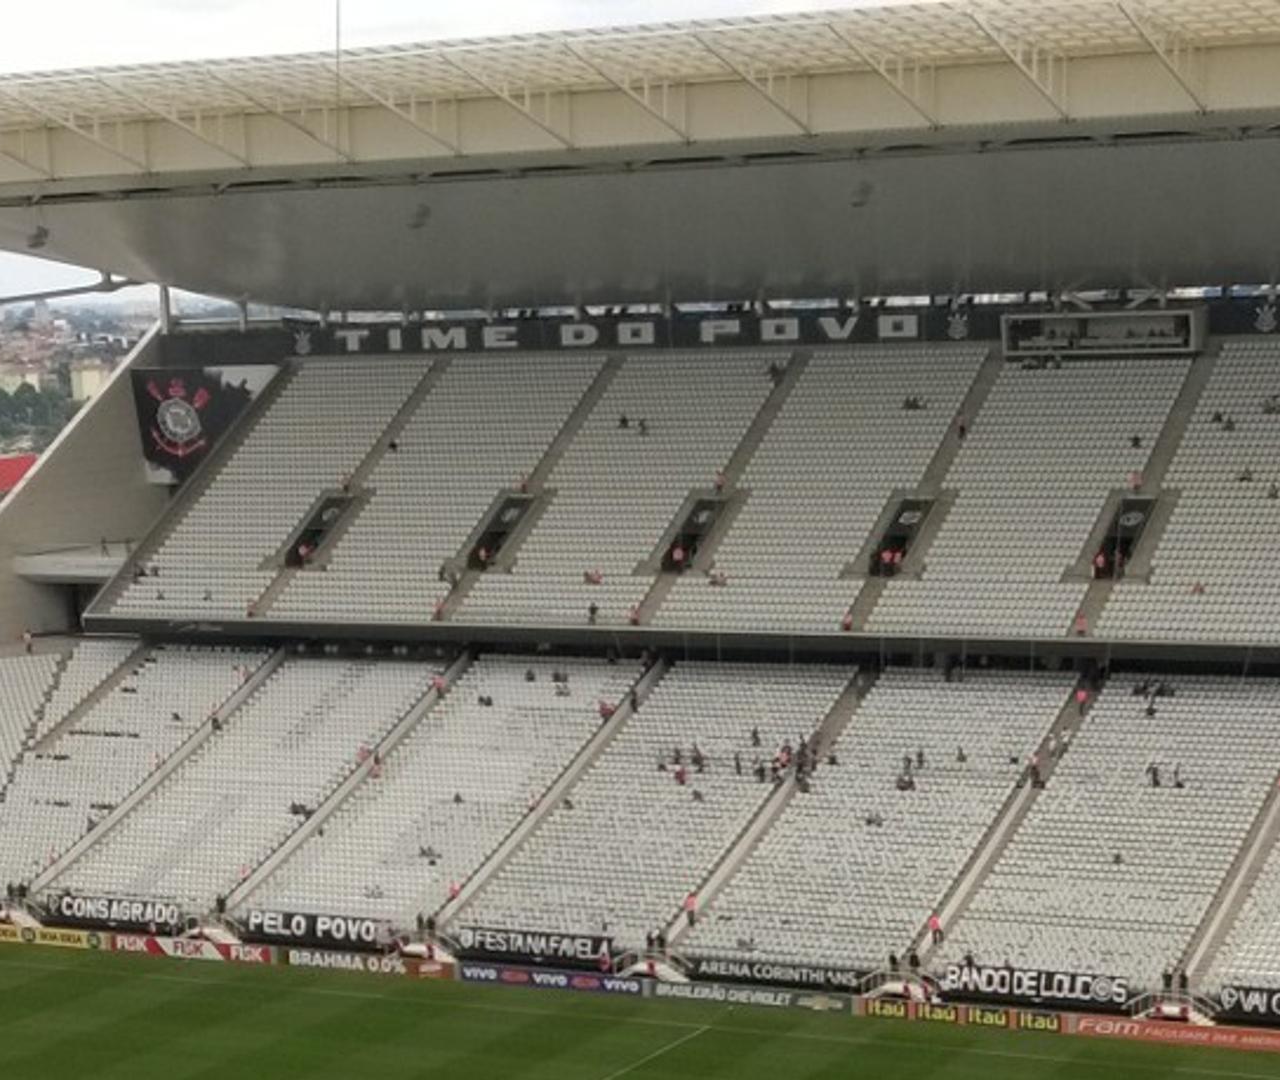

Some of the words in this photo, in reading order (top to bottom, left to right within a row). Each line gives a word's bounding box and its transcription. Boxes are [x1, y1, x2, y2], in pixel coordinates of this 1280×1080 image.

[334, 326, 518, 351] TIME
[560, 321, 654, 346] DO
[700, 314, 918, 342] POVO
[61, 896, 178, 924] CONSAGRADO
[248, 910, 306, 936] PELO
[316, 916, 376, 942] POVO
[288, 951, 364, 971] BRAHMA
[699, 960, 751, 977] ARENA
[947, 965, 1010, 994] BANDO
[1013, 970, 1038, 995] DE
[1240, 990, 1268, 1014] VAI
